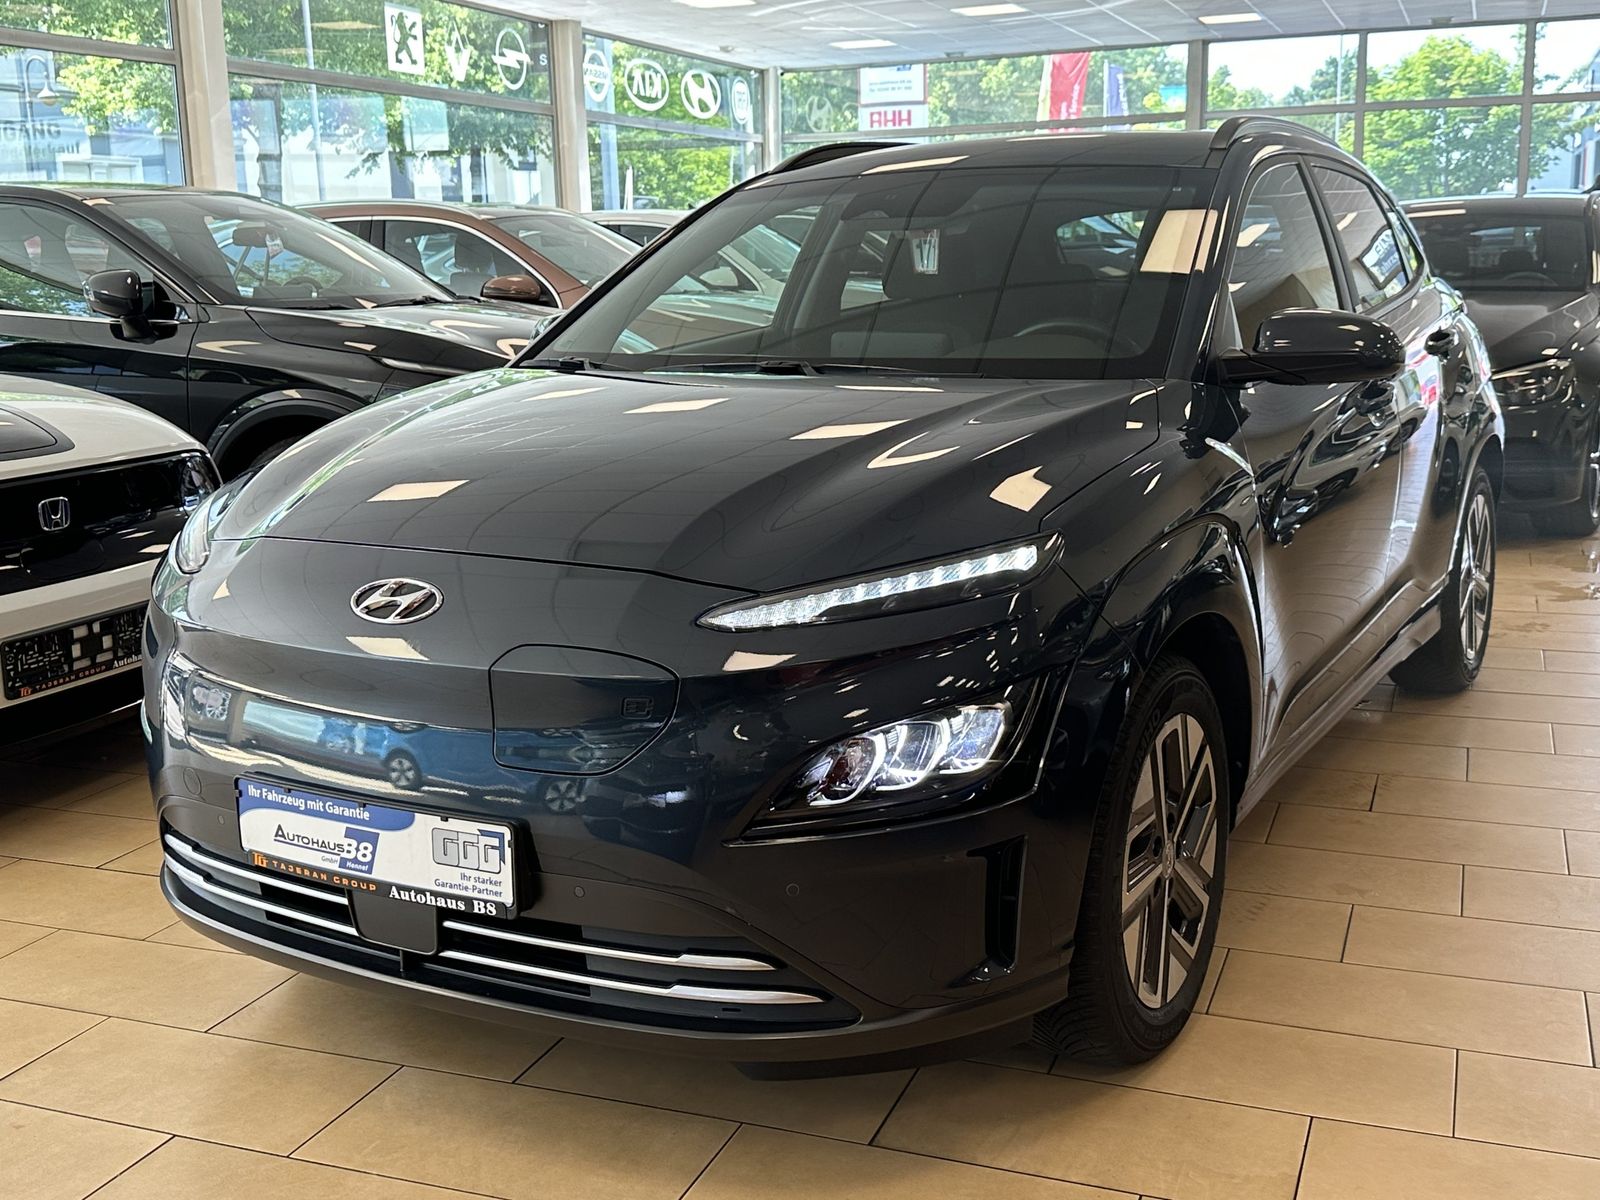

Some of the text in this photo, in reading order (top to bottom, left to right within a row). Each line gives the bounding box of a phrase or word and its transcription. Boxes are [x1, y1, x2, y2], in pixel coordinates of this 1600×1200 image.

[0, 121, 62, 141] GANG
[79, 665, 107, 678] GROUP
[112, 654, 143, 669] Autoha
[248, 785, 370, 821] Ihr Fahrzeug mit Garantie
[321, 855, 339, 865] GmbH
[346, 860, 369, 872] Hennef
[333, 875, 377, 891] GROUP
[434, 878, 503, 898] Garantie-Partner
[460, 872, 502, 888] Ihr starker
[389, 885, 497, 916] Autohaus B8
